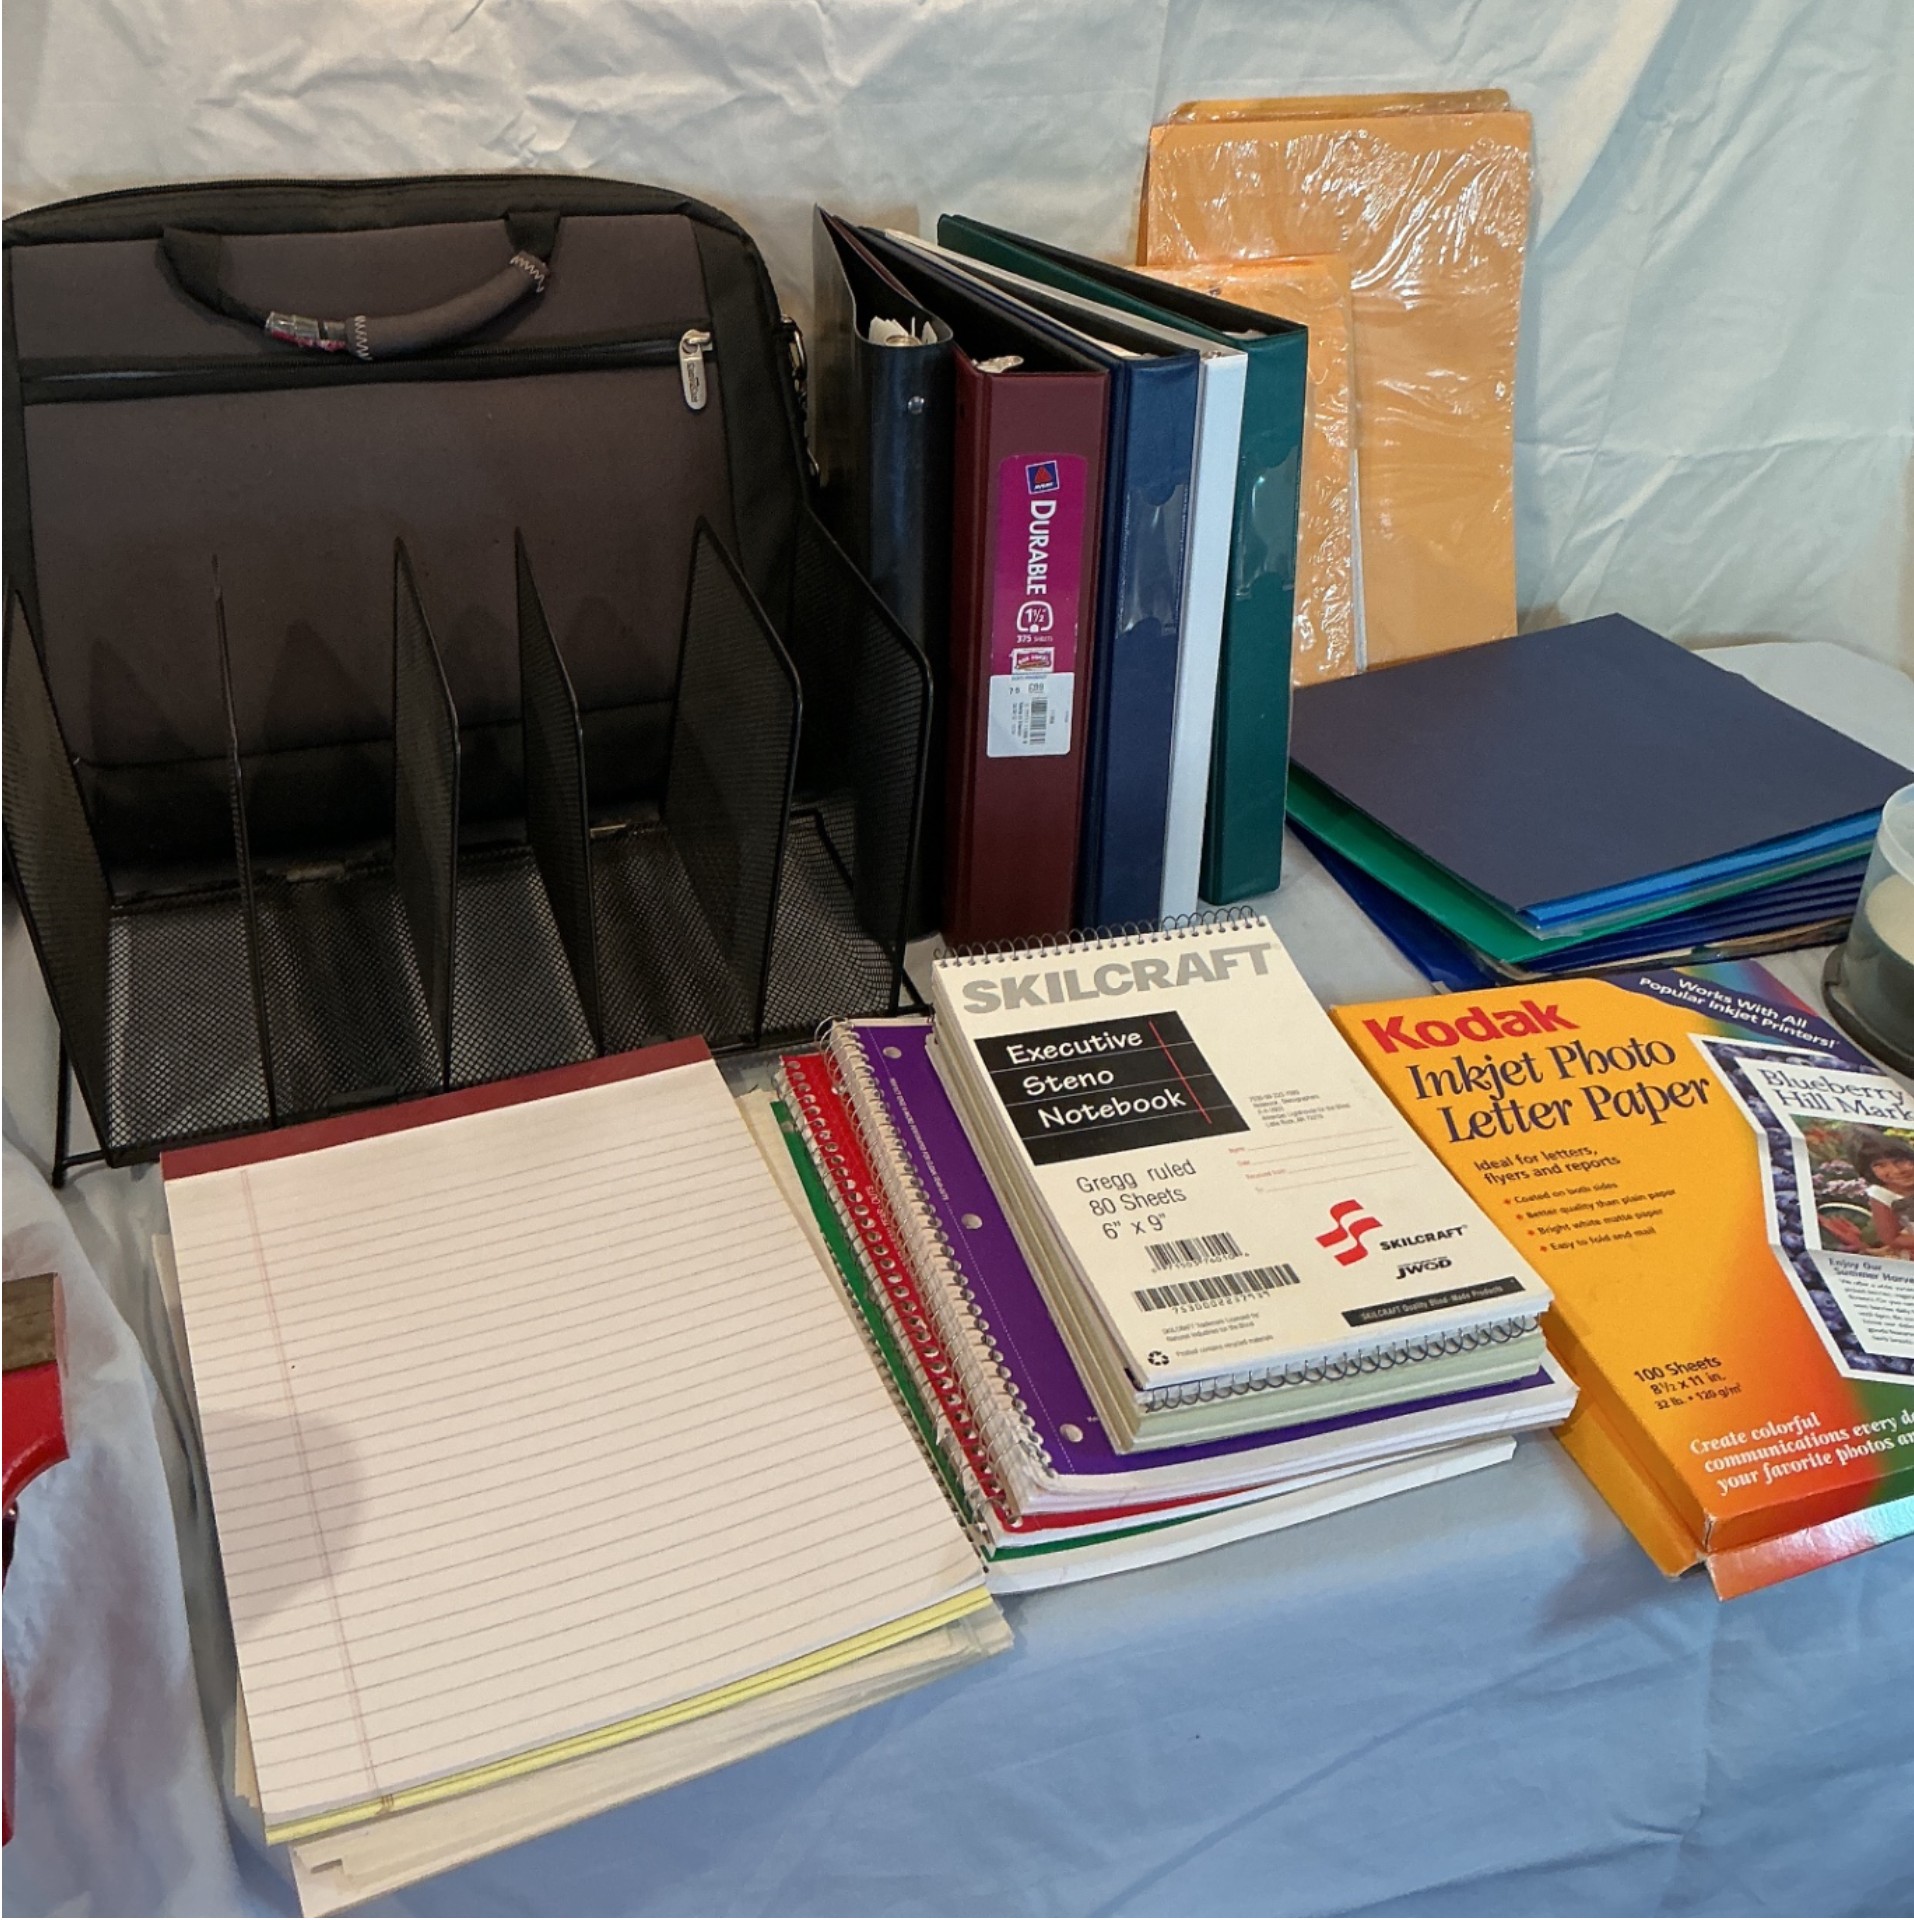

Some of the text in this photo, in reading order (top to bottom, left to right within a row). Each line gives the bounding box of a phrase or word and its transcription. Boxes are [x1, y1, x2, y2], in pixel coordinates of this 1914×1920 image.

[1026, 500, 1057, 595] DURABLE
[1017, 634, 1032, 643] 375
[962, 943, 1271, 1014] SKILCRAFT
[1639, 976, 1708, 1005] Popular
[1709, 1000, 1759, 1024] Inkjet
[1678, 977, 1808, 1029] Works With All
[1362, 1000, 1581, 1053] Kodak
[1006, 1031, 1143, 1065] Executive
[1023, 1069, 1114, 1096] Steno
[1405, 1038, 1676, 1102] Inkjet Photo
[1758, 1069, 1905, 1107] Blueberry
[1038, 1088, 1187, 1128] Notebook
[1437, 1077, 1710, 1143] Letter Paper
[1772, 1089, 1914, 1121] Hill Mark
[1474, 1146, 1598, 1172] Ideal for letters,
[1484, 1155, 1621, 1185] flyers and reports
[1076, 1159, 1197, 1193] Gregg ruled
[1089, 1187, 1187, 1216] 80 Sheets
[1514, 1182, 1618, 1203] Coated on both sides
[1526, 1189, 1676, 1219] Better quality than plain paper
[1102, 1213, 1166, 1240] 6" x 9"
[1537, 1208, 1663, 1235] Bright white matte paper
[1380, 1226, 1463, 1250] SKILCRAFT
[1550, 1227, 1656, 1251] Easy to fold and mail
[1396, 1259, 1452, 1279] JWOD
[1828, 1257, 1882, 1271] Enjoy Our
[1834, 1267, 1878, 1279] Summer
[1361, 1306, 1402, 1320] SKILCRAFT
[1402, 1302, 1428, 1313] Quality
[1471, 1285, 1503, 1298] Products
[1634, 1356, 1722, 1382] 100 Sheets
[1678, 1379, 1690, 1389] x
[1688, 1375, 1705, 1385] 11
[1705, 1372, 1726, 1383] in.
[1655, 1400, 1670, 1410] 32
[1696, 1389, 1717, 1400] 120
[1689, 1412, 1821, 1455] Create colorful
[1704, 1427, 1849, 1473] communications
[1852, 1416, 1898, 1437] every
[1717, 1470, 1759, 1496] your
[1762, 1452, 1833, 1485] favorite
[1836, 1437, 1895, 1465] photos
